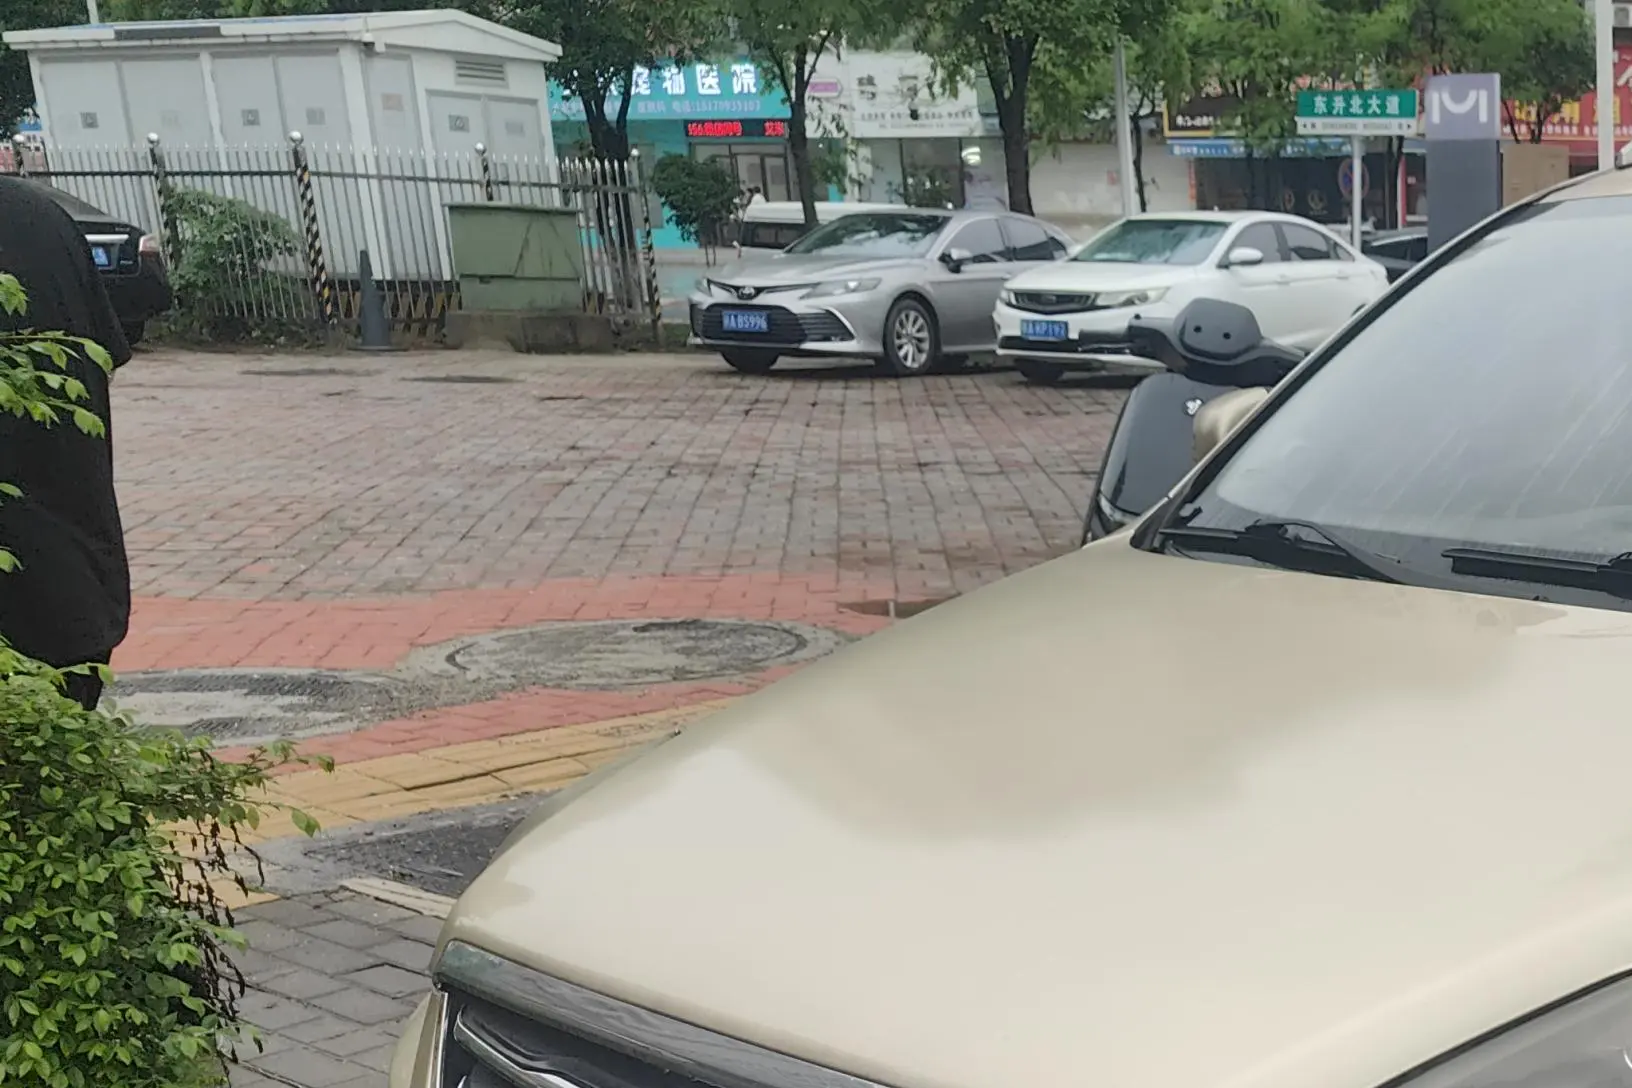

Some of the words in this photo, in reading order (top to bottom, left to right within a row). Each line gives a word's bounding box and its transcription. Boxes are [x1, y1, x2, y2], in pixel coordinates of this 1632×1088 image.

[1313, 94, 1401, 115] 东升北大道
